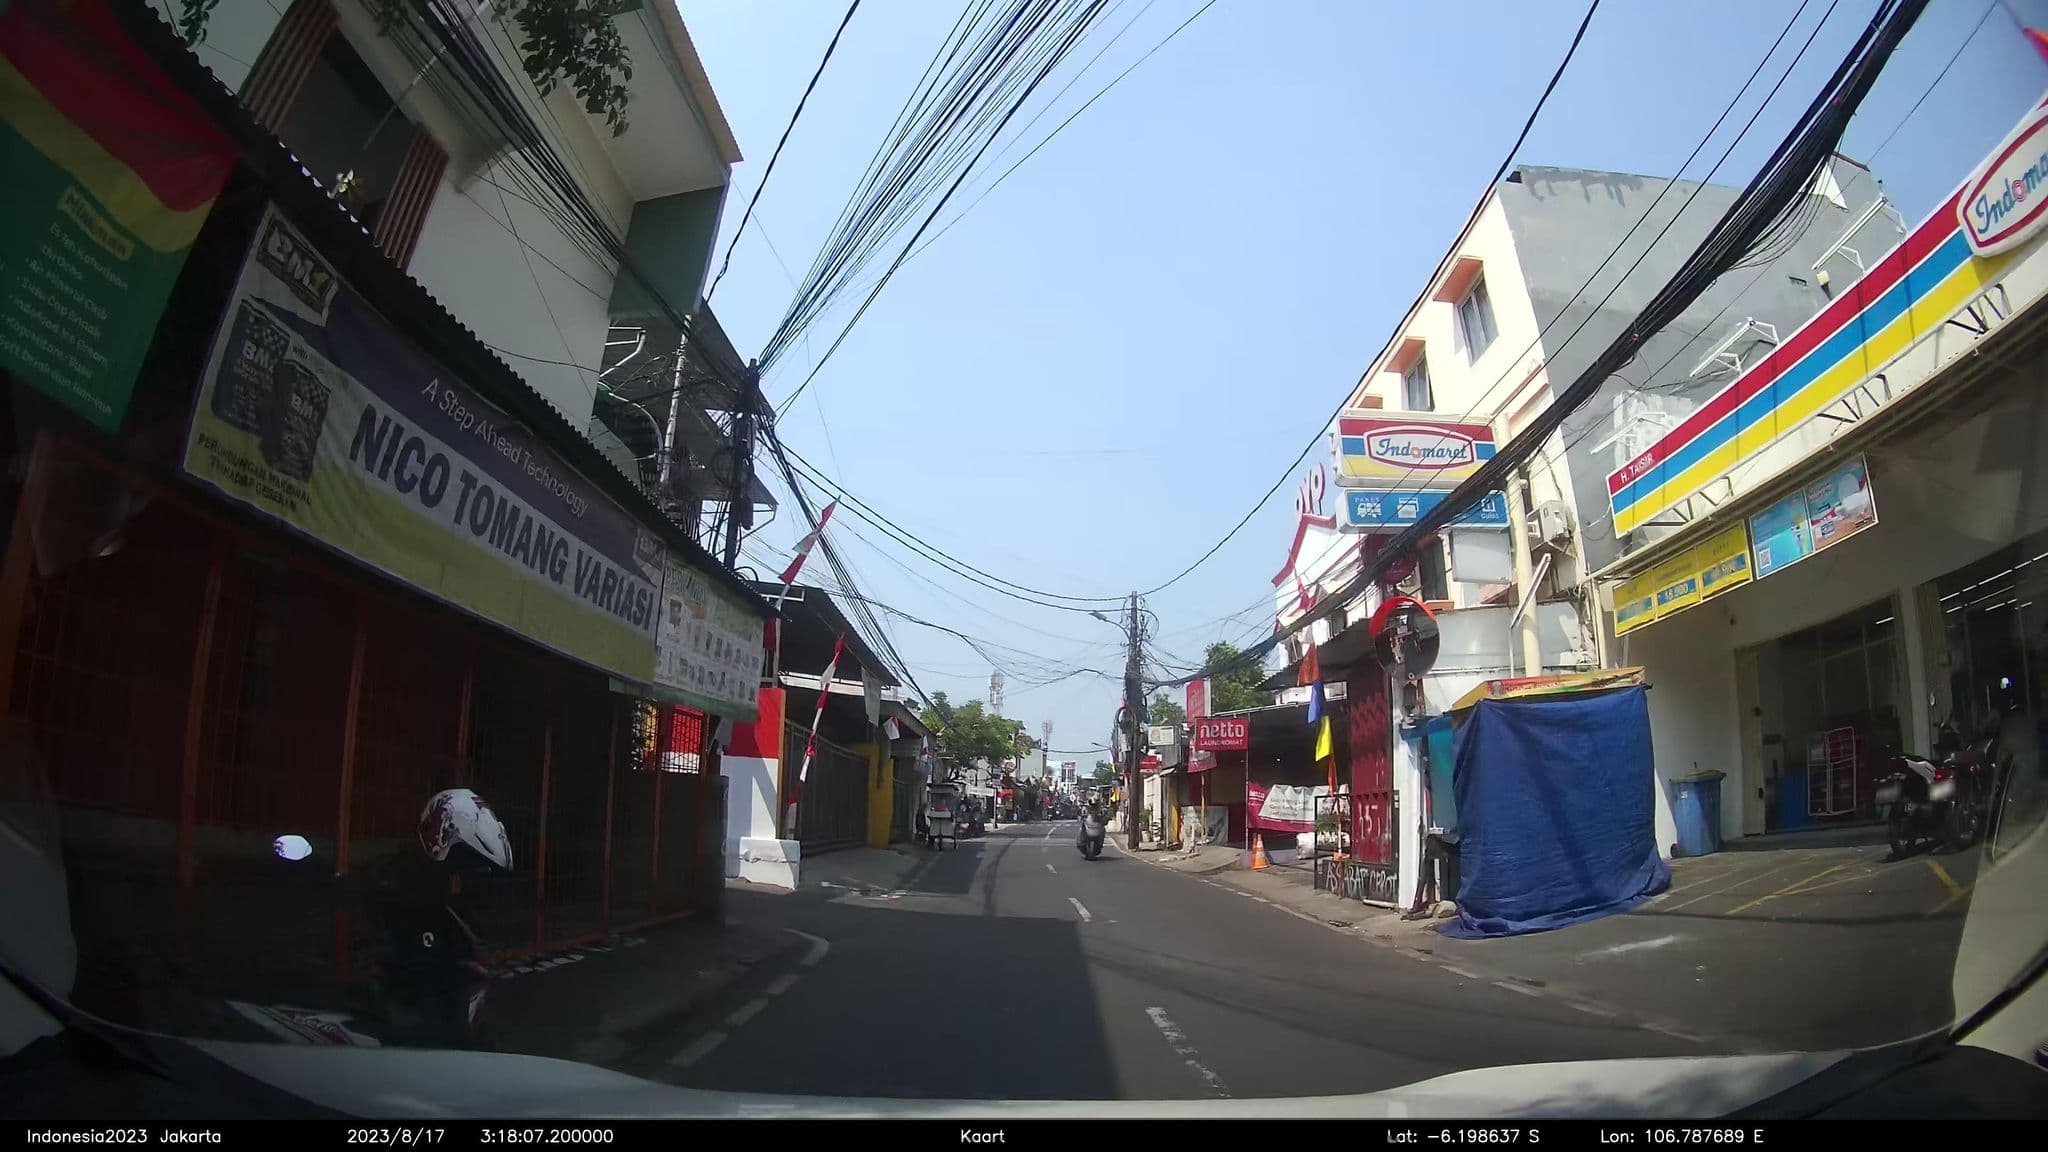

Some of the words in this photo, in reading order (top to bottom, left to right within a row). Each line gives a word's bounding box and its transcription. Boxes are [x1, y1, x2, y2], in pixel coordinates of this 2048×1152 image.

[421, 378, 439, 402] A
[438, 389, 474, 432] Step
[474, 419, 522, 465] Ahead
[523, 449, 590, 518] Technology
[1376, 438, 1468, 459] Indomaret
[350, 403, 451, 509] NICO
[453, 470, 570, 586] TOMANG
[573, 549, 656, 632] VARIASI
[1200, 722, 1244, 738] netto
